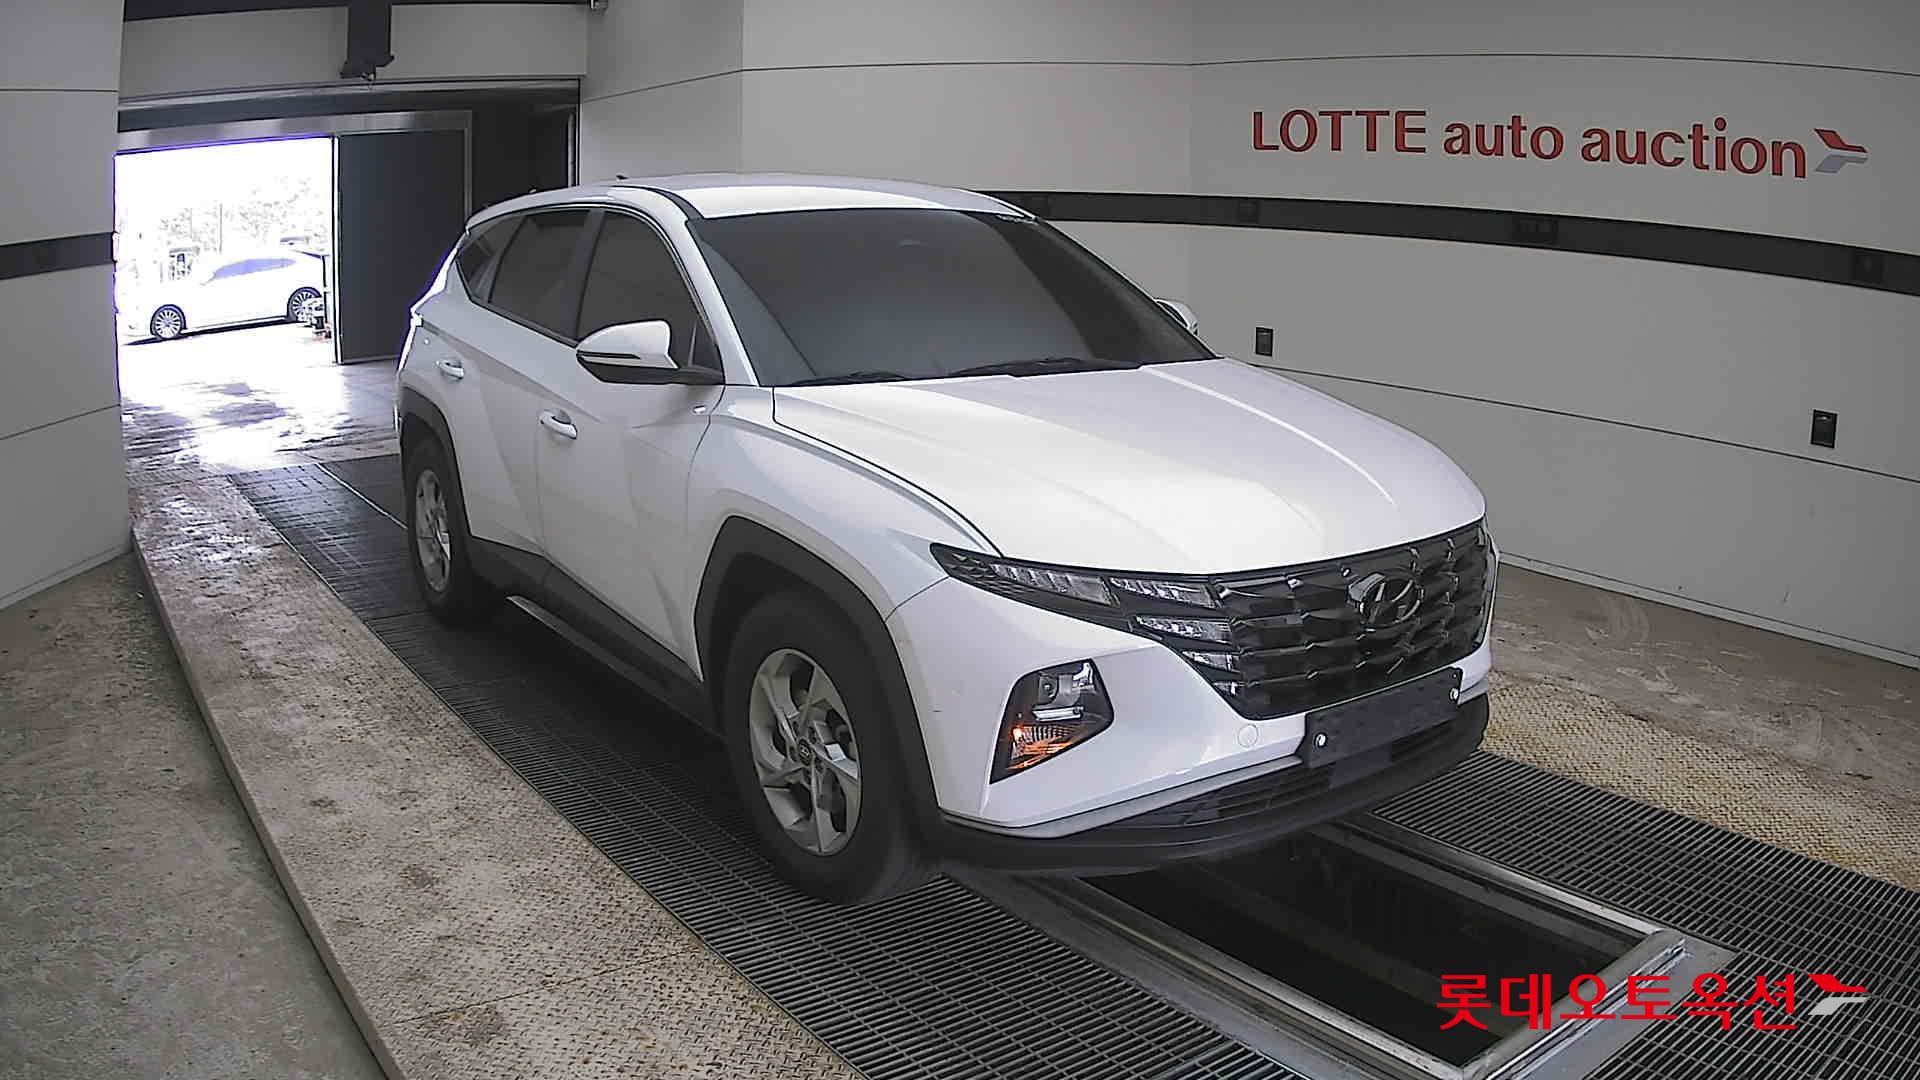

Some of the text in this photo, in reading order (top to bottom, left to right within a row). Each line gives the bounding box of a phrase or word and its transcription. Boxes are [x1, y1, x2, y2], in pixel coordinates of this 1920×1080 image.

[1252, 109, 1807, 179] LOTTE auto auction
